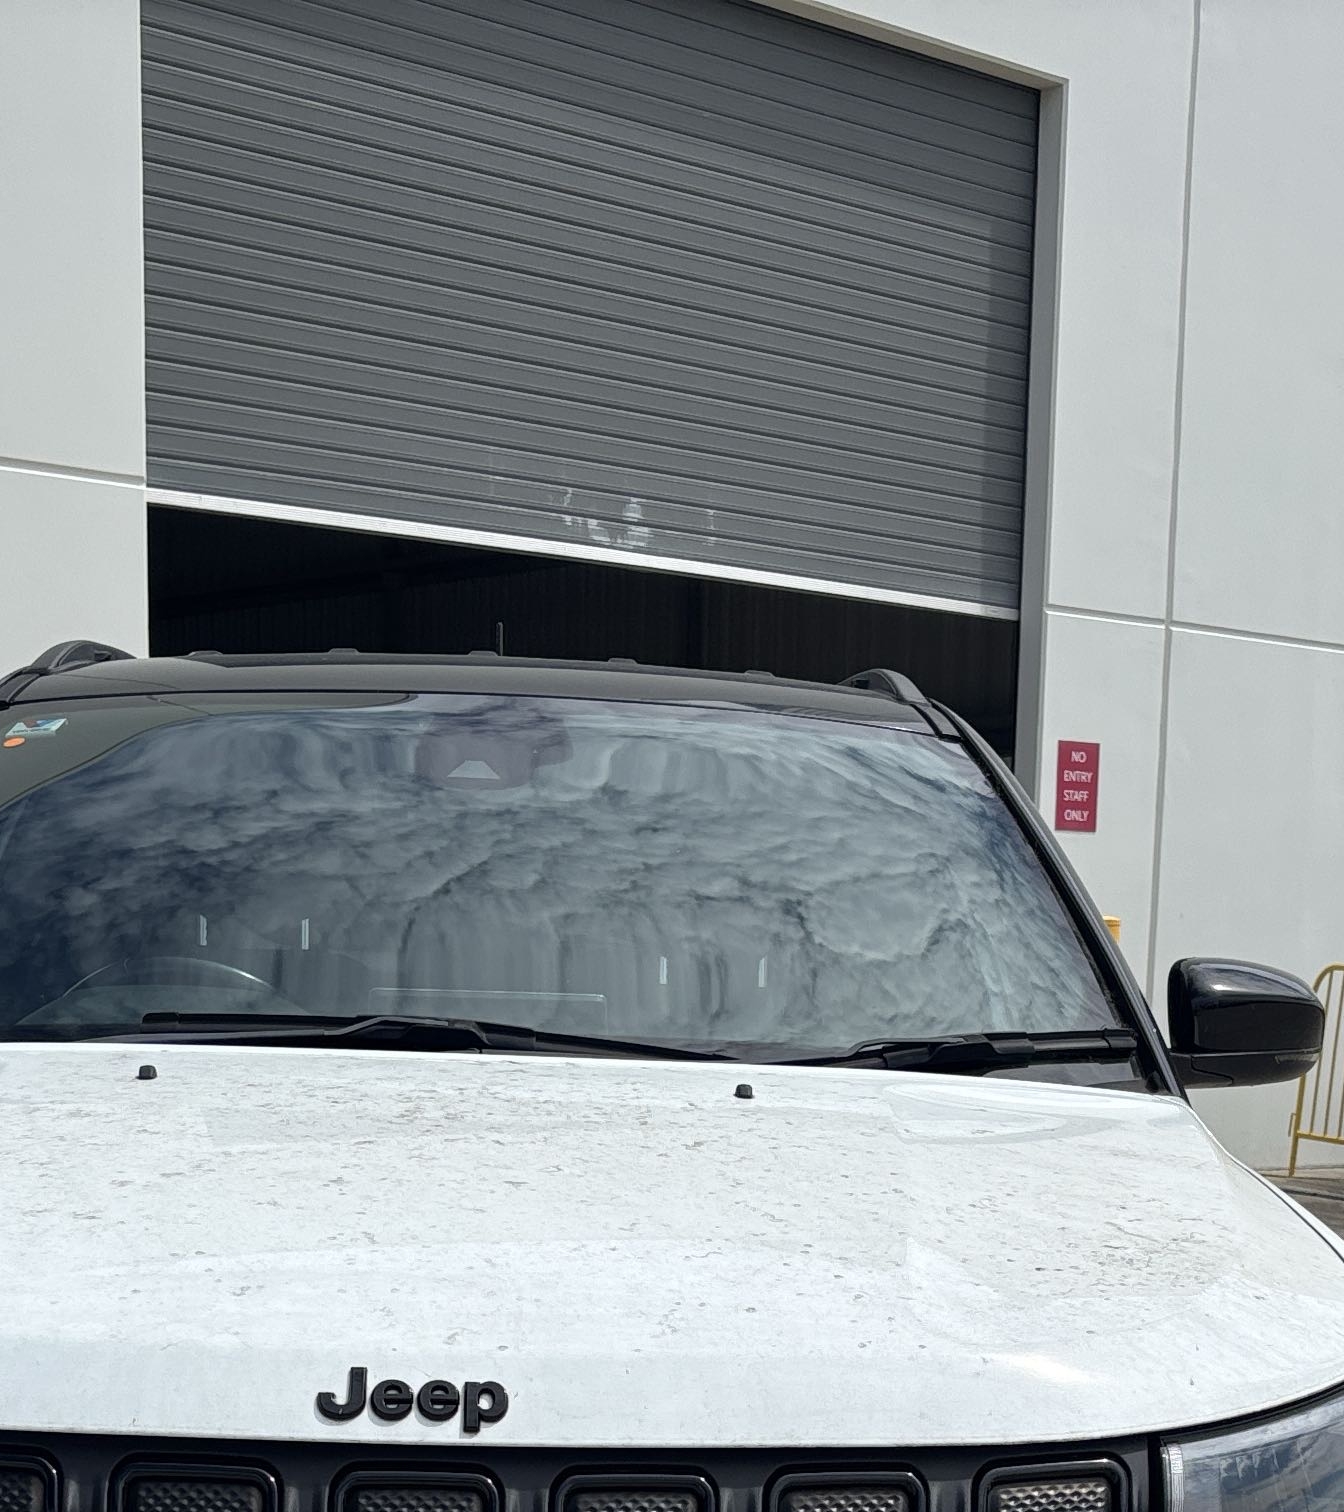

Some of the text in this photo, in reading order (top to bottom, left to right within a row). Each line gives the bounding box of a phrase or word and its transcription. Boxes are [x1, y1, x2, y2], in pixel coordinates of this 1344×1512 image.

[1071, 751, 1087, 763] NO
[1063, 770, 1093, 783] ENTRY
[1063, 789, 1089, 802] STAFF
[1063, 809, 1089, 822] ONLY
[316, 1366, 509, 1434] Jeep
